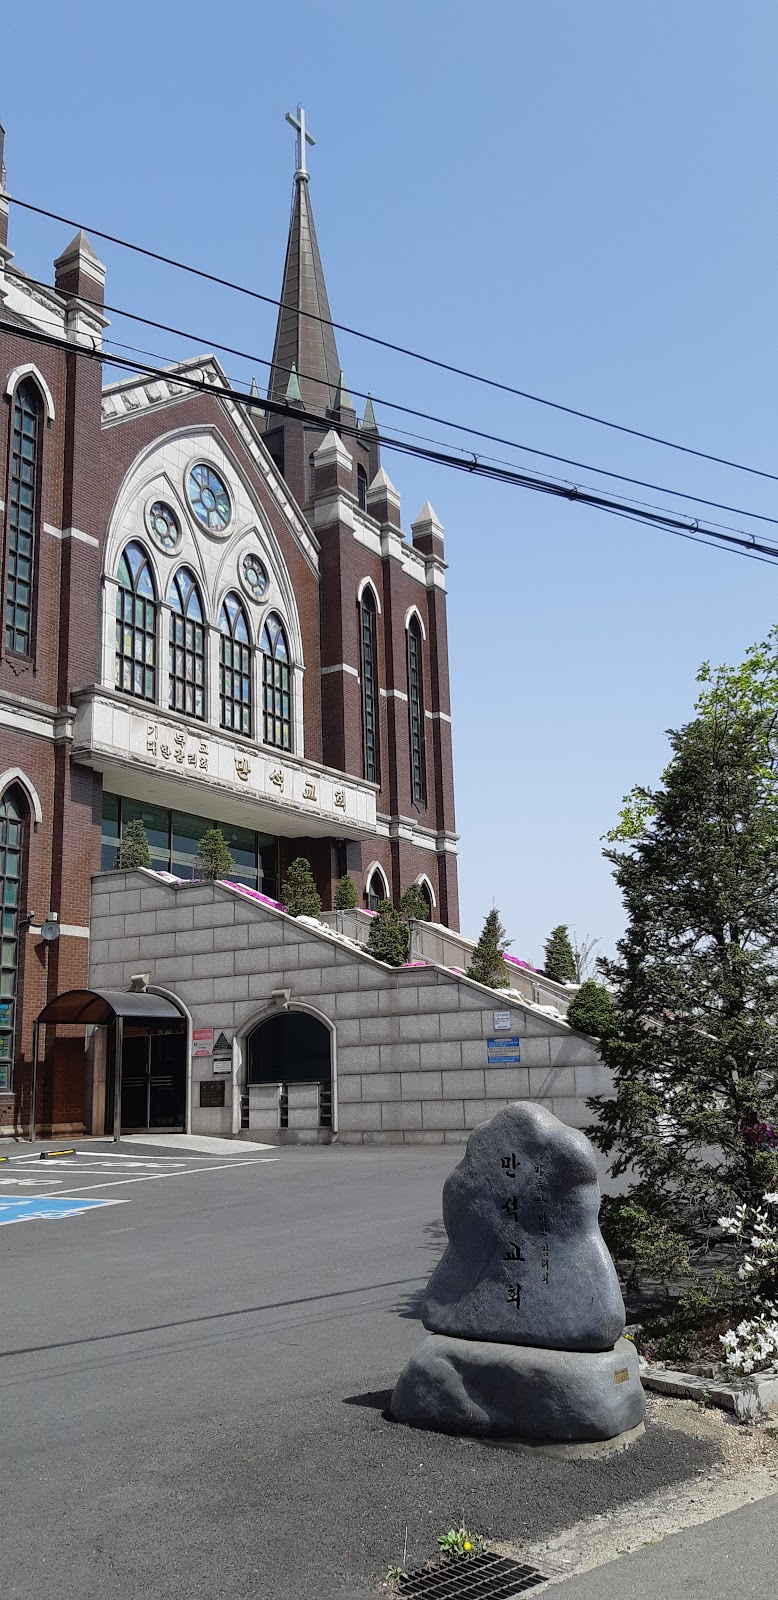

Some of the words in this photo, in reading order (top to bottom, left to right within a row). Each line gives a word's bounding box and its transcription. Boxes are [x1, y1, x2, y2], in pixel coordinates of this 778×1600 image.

[146, 725, 209, 756] 기독교
[146, 741, 208, 772] 대한감리회
[234, 758, 347, 812] 만석교회
[500, 1152, 526, 1310] 만석교회
